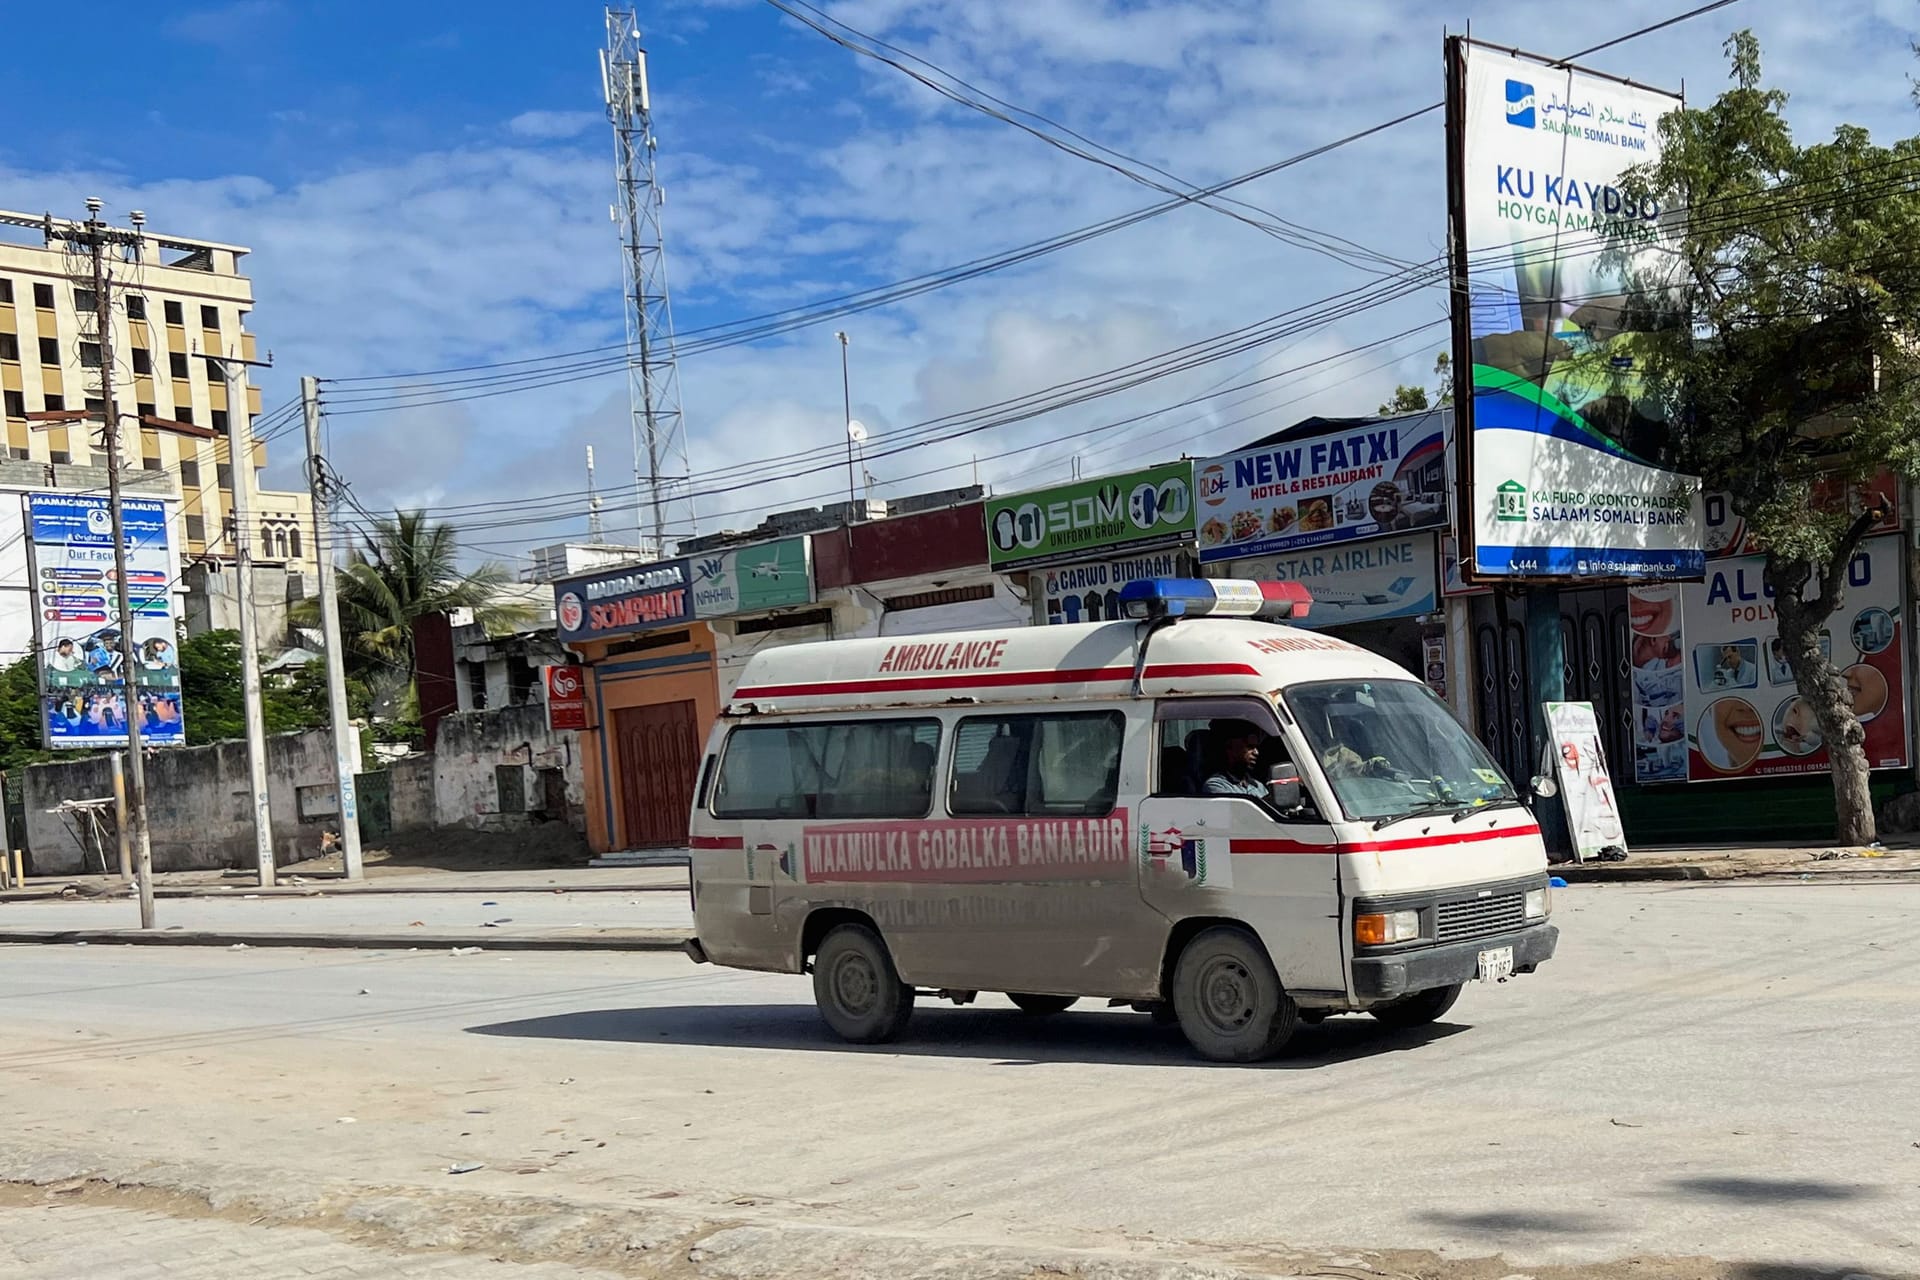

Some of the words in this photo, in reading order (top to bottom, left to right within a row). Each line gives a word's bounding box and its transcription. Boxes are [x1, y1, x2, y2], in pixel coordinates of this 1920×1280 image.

[1599, 106, 1624, 127] سلام
[1542, 118, 1582, 138] SALAAM
[1584, 128, 1619, 146] SOMALI
[1621, 135, 1646, 151] BANK
[1497, 165, 1534, 199] KU
[1545, 174, 1660, 221] KAYDSO
[1498, 200, 1558, 226] HOYGA
[1565, 212, 1659, 243] AMAANADA
[1234, 448, 1302, 488] NEW
[1311, 428, 1399, 474] FATXI
[1251, 483, 1288, 500] HOTEL
[1290, 480, 1300, 493] &
[1302, 465, 1383, 491] RESTAURANT
[1533, 491, 1548, 504] KA
[1553, 492, 1586, 506] FURO
[1589, 494, 1639, 507] KOONTO
[101, 501, 163, 511] SMAALIYA
[1048, 488, 1124, 533] SOM
[1533, 506, 1590, 522] SALAAM
[1594, 509, 1643, 524] SOMALI
[1648, 511, 1684, 525] BANK
[1050, 527, 1092, 547] UNIFORM
[1095, 521, 1126, 539] GROUP
[68, 549, 86, 560] Our
[90, 550, 135, 562] Facues
[1060, 565, 1107, 589] CARWO
[1112, 554, 1172, 583] BIDHAAN
[1276, 557, 1325, 580] STAR
[1331, 543, 1414, 573] AIRLINE
[1519, 560, 1537, 570] 444
[1589, 560, 1676, 572] info@salaambank.so
[586, 567, 684, 600] MADBACADDA
[590, 590, 685, 630] SOMPRINT
[878, 639, 1008, 672] AMBULANCE
[808, 829, 912, 873] MAAMULKA
[917, 825, 1010, 870] GOBALKA
[1017, 818, 1126, 866] BANAADIR
